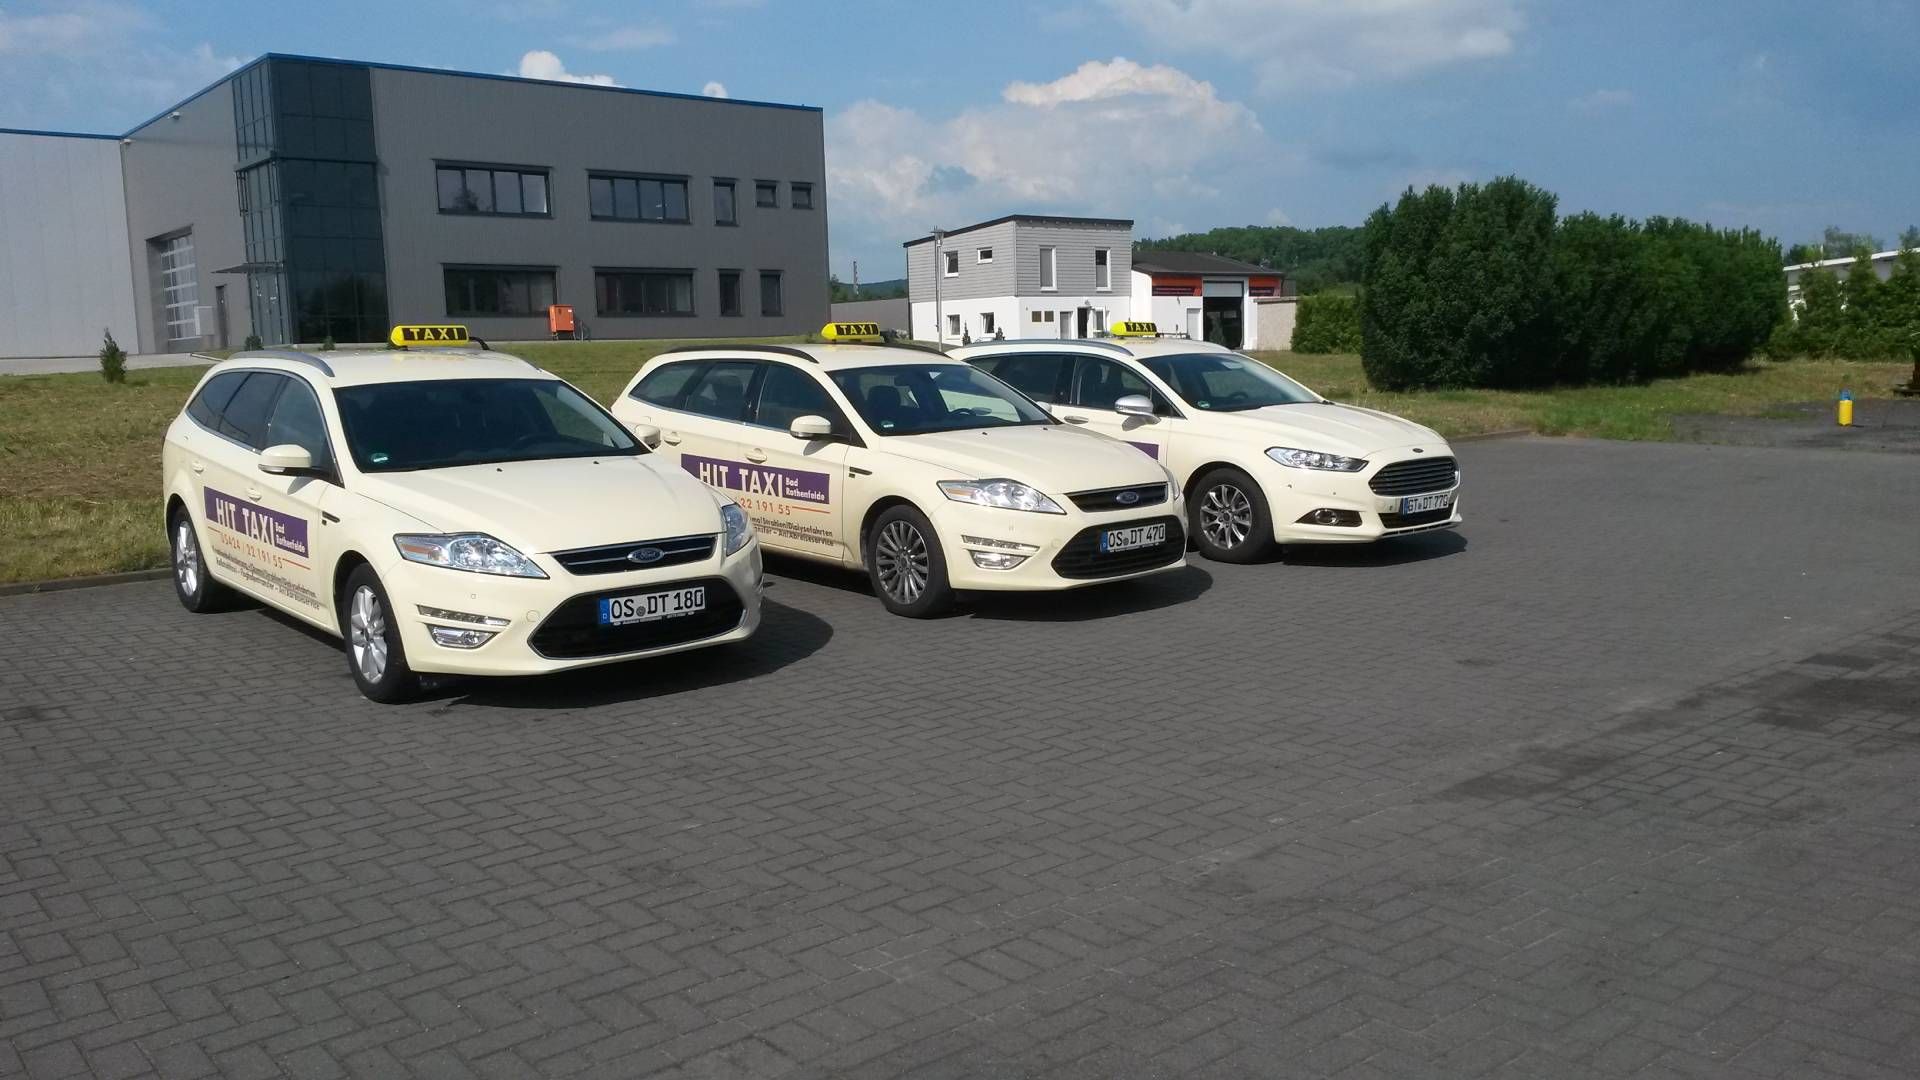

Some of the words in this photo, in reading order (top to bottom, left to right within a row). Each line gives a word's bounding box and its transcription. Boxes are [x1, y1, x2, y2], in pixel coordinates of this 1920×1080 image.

[410, 328, 459, 340] TAXI
[840, 325, 873, 335] TAXI
[1128, 322, 1153, 332] TAXI
[700, 462, 728, 488] HIT
[739, 468, 783, 498] TAXI
[785, 477, 799, 487] Bad
[785, 487, 825, 501] Rothenfelde
[756, 500, 774, 513] 191
[778, 503, 791, 516] 55
[216, 498, 236, 531] HIT
[242, 507, 275, 547] TAXI
[1108, 532, 1123, 547] OS
[1130, 528, 1144, 544] DT
[1146, 525, 1165, 541] 470
[611, 599, 635, 619] OS
[647, 594, 669, 615] DT
[673, 589, 704, 611] 180
